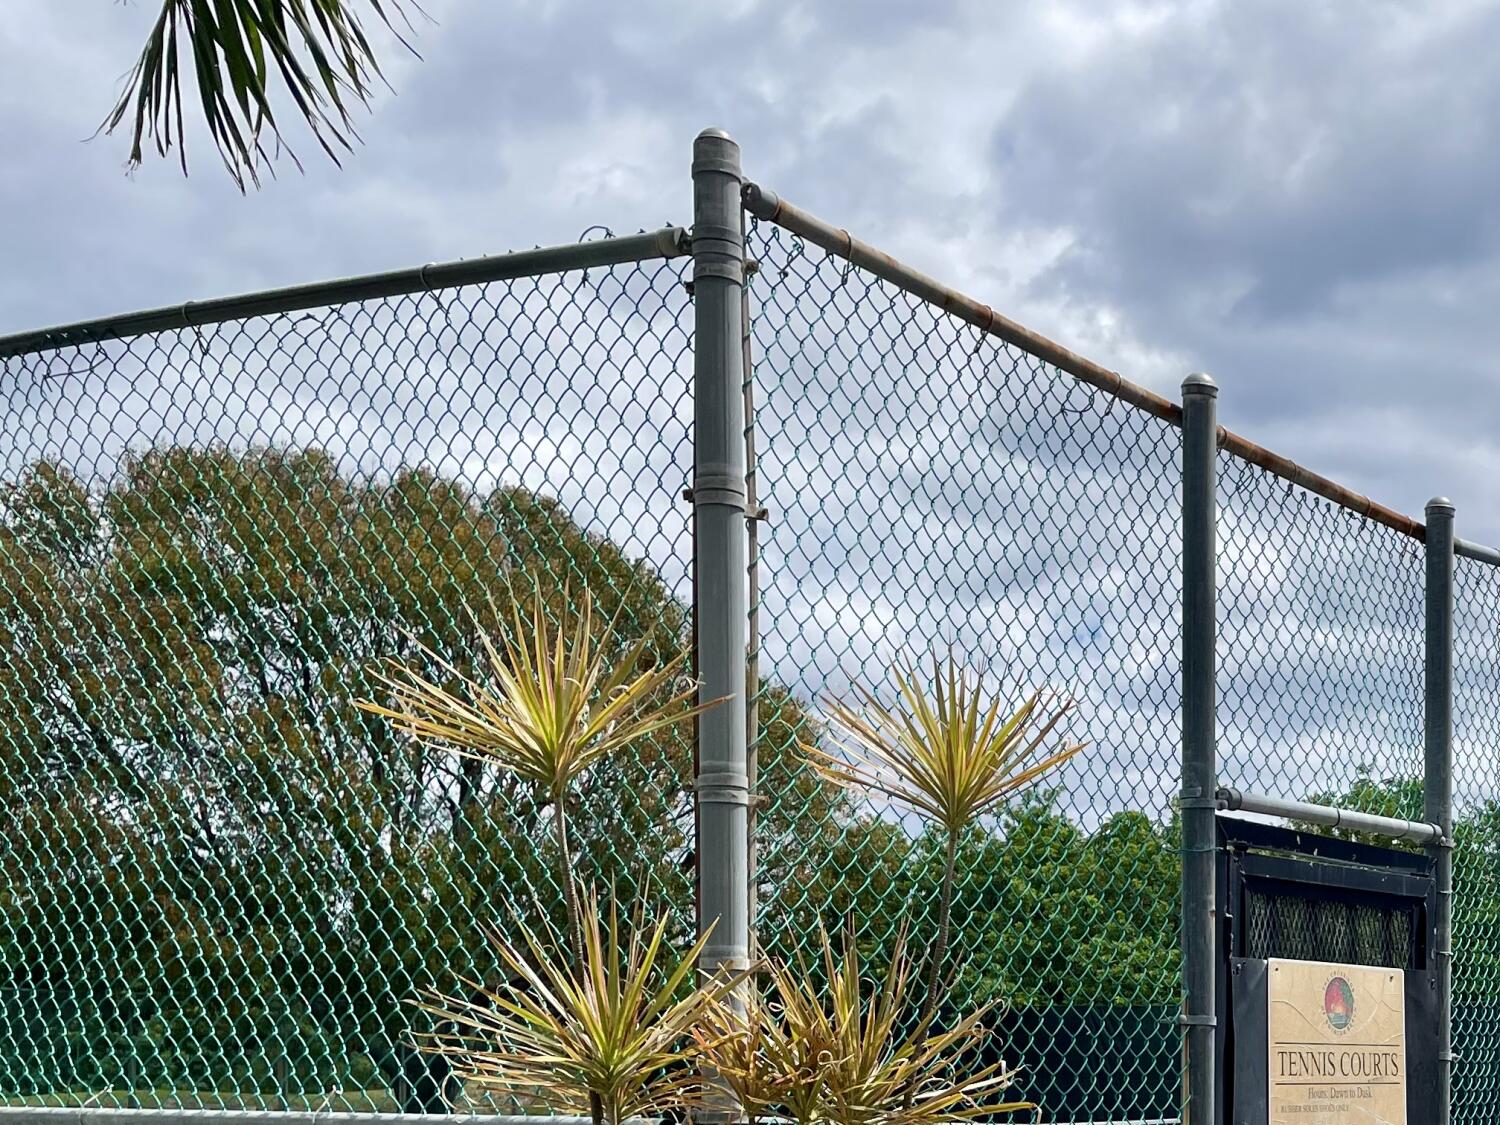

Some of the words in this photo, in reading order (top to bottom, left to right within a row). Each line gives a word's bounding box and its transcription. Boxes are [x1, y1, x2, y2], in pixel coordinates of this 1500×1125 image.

[1278, 1051, 1336, 1077] TENNIS
[1340, 1051, 1399, 1077] COURTS
[1330, 1087, 1349, 1099] Dawn
[1350, 1089, 1356, 1098] to
[1357, 1086, 1372, 1098] Dusk
